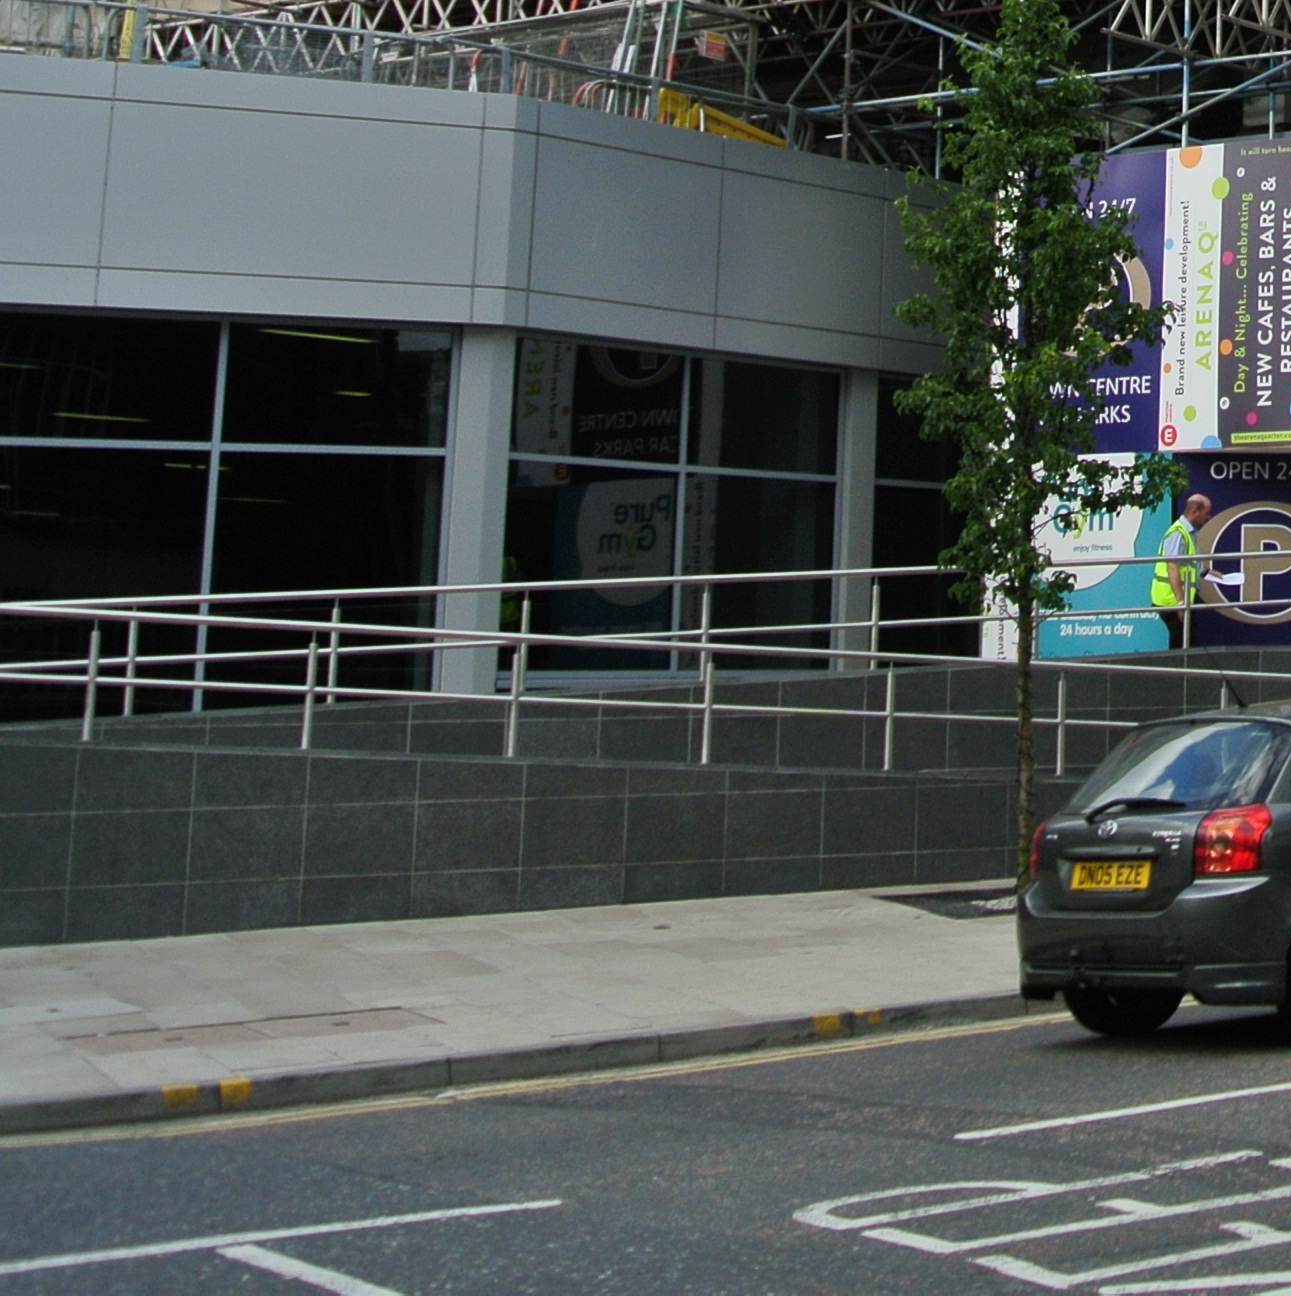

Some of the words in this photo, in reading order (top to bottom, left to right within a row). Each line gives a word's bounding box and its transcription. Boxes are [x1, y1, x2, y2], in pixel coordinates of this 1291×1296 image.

[1261, 176, 1276, 191] &
[1178, 200, 1191, 283] development!
[1236, 192, 1253, 279] Celebrating
[1259, 199, 1275, 259] BARS
[1257, 265, 1276, 345] CAFES,
[1234, 346, 1246, 358] &
[1175, 359, 1185, 396] Brand
[1234, 364, 1249, 392] Day
[1257, 353, 1272, 407] NEW
[1210, 461, 1269, 481] OPEN
[1073, 544, 1089, 553] enjoy
[1091, 543, 1113, 552] fitness
[1060, 624, 1073, 636] 24
[1075, 623, 1102, 635] hours
[1104, 625, 1111, 635] a
[1114, 622, 1133, 638] day
[1115, 864, 1144, 885] EZE
